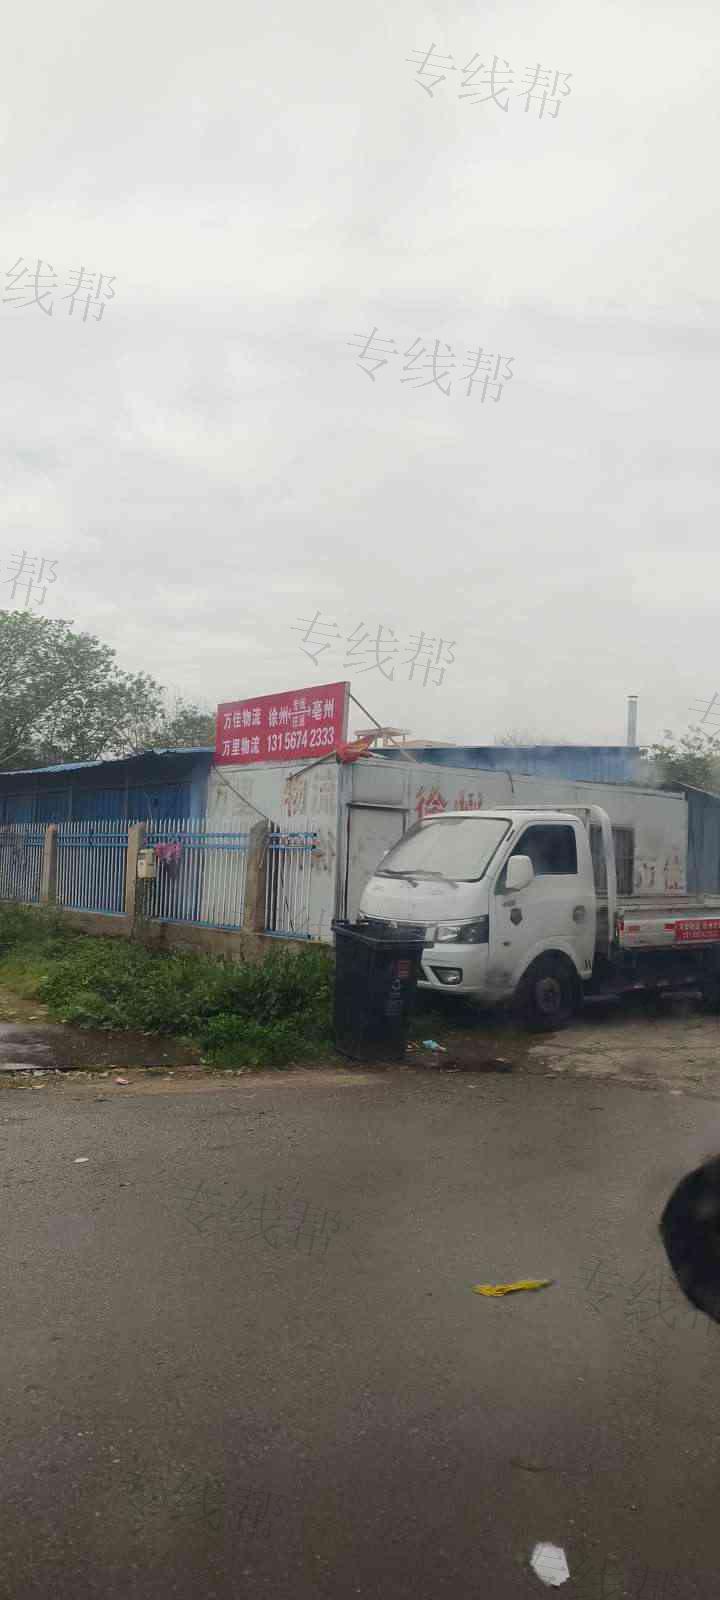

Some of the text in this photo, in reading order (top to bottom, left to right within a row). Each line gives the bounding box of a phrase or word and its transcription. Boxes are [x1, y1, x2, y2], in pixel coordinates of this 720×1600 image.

[223, 707, 262, 730] 万佳物流
[268, 705, 289, 728] 徐州
[221, 726, 335, 757] 万里物流 131 5674 2333
